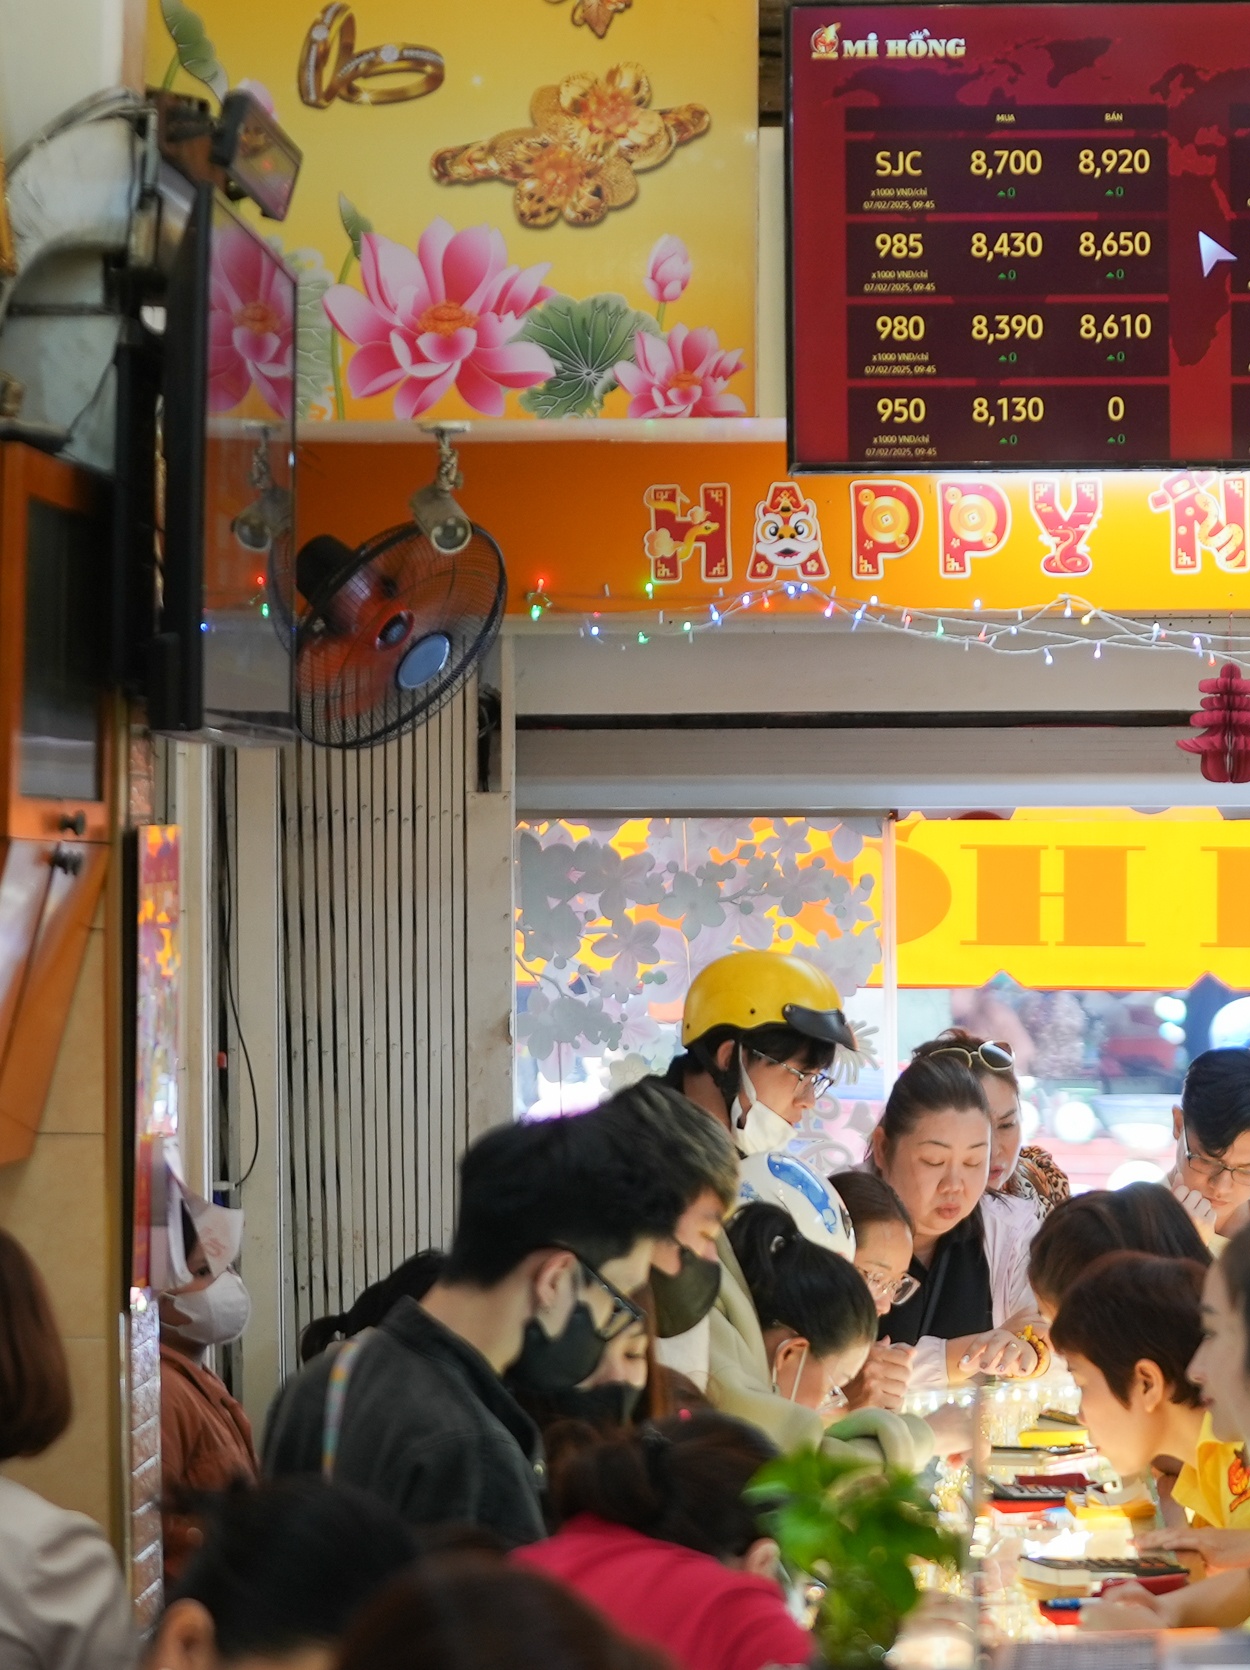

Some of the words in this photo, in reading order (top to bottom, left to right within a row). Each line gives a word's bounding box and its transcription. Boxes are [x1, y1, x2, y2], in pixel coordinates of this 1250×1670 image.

[995, 113, 1016, 123] MUA
[1104, 112, 1123, 122] BÁN
[875, 150, 922, 176] SJC
[970, 149, 1042, 179] 8,700
[1078, 148, 1151, 178] 8,920
[870, 187, 895, 198] x1000
[875, 233, 924, 258] 985
[970, 231, 1043, 262] 8,430
[1079, 231, 1151, 261] 8,650
[871, 269, 896, 280] x1000
[876, 315, 925, 341] 980
[971, 314, 1044, 344] 8,390
[1079, 313, 1152, 343] 8,610
[871, 352, 896, 363] x1000
[876, 397, 926, 423] 950
[972, 396, 1044, 427] 8,130
[1107, 396, 1125, 421] 0
[872, 434, 897, 445] x1000
[644, 479, 1098, 583] HAPPY
